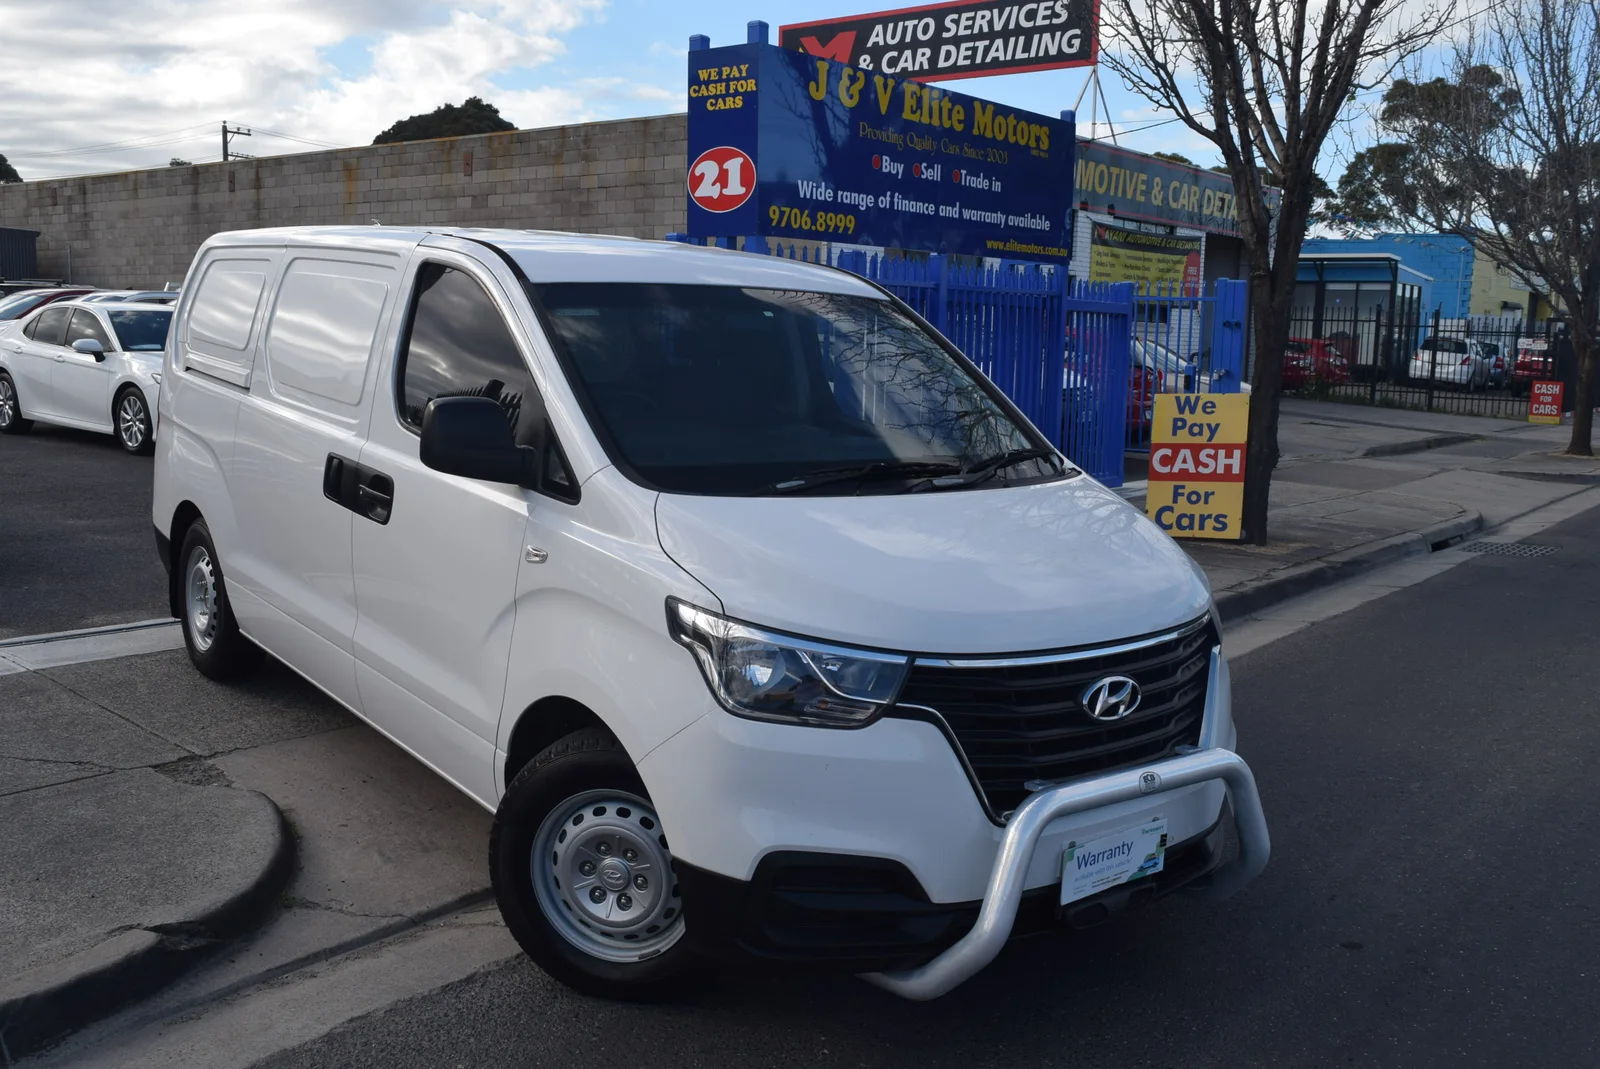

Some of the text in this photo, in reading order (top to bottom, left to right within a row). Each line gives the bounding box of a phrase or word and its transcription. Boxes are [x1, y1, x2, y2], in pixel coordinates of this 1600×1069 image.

[867, 0, 1069, 48] AUTO SERVICES
[858, 29, 1081, 74] & CAR DETAILING
[698, 64, 749, 81] WE PAY
[689, 79, 756, 98] CASH FOR
[706, 96, 743, 111] CARS
[809, 60, 1050, 150] J & V Elite Motors
[860, 121, 1008, 164] Providing Quality Cars Since 2003
[694, 157, 746, 199] 21
[881, 156, 1002, 192] Buy Sell Trade in
[1074, 158, 1239, 221] MOTIVE & CAR DETA
[797, 179, 1050, 231] Wide range of finance and warranty available
[769, 205, 856, 235] 9706.8999
[986, 238, 1068, 257] www.elitemotors.com.au
[1534, 384, 1560, 394] CASH
[1174, 395, 1217, 415] We
[1532, 404, 1558, 415] CARS
[1171, 417, 1221, 442] Pay
[1152, 448, 1241, 474] CASH
[1172, 485, 1215, 505] For
[1154, 505, 1228, 532] Cars
[1076, 841, 1134, 870] Warranty
